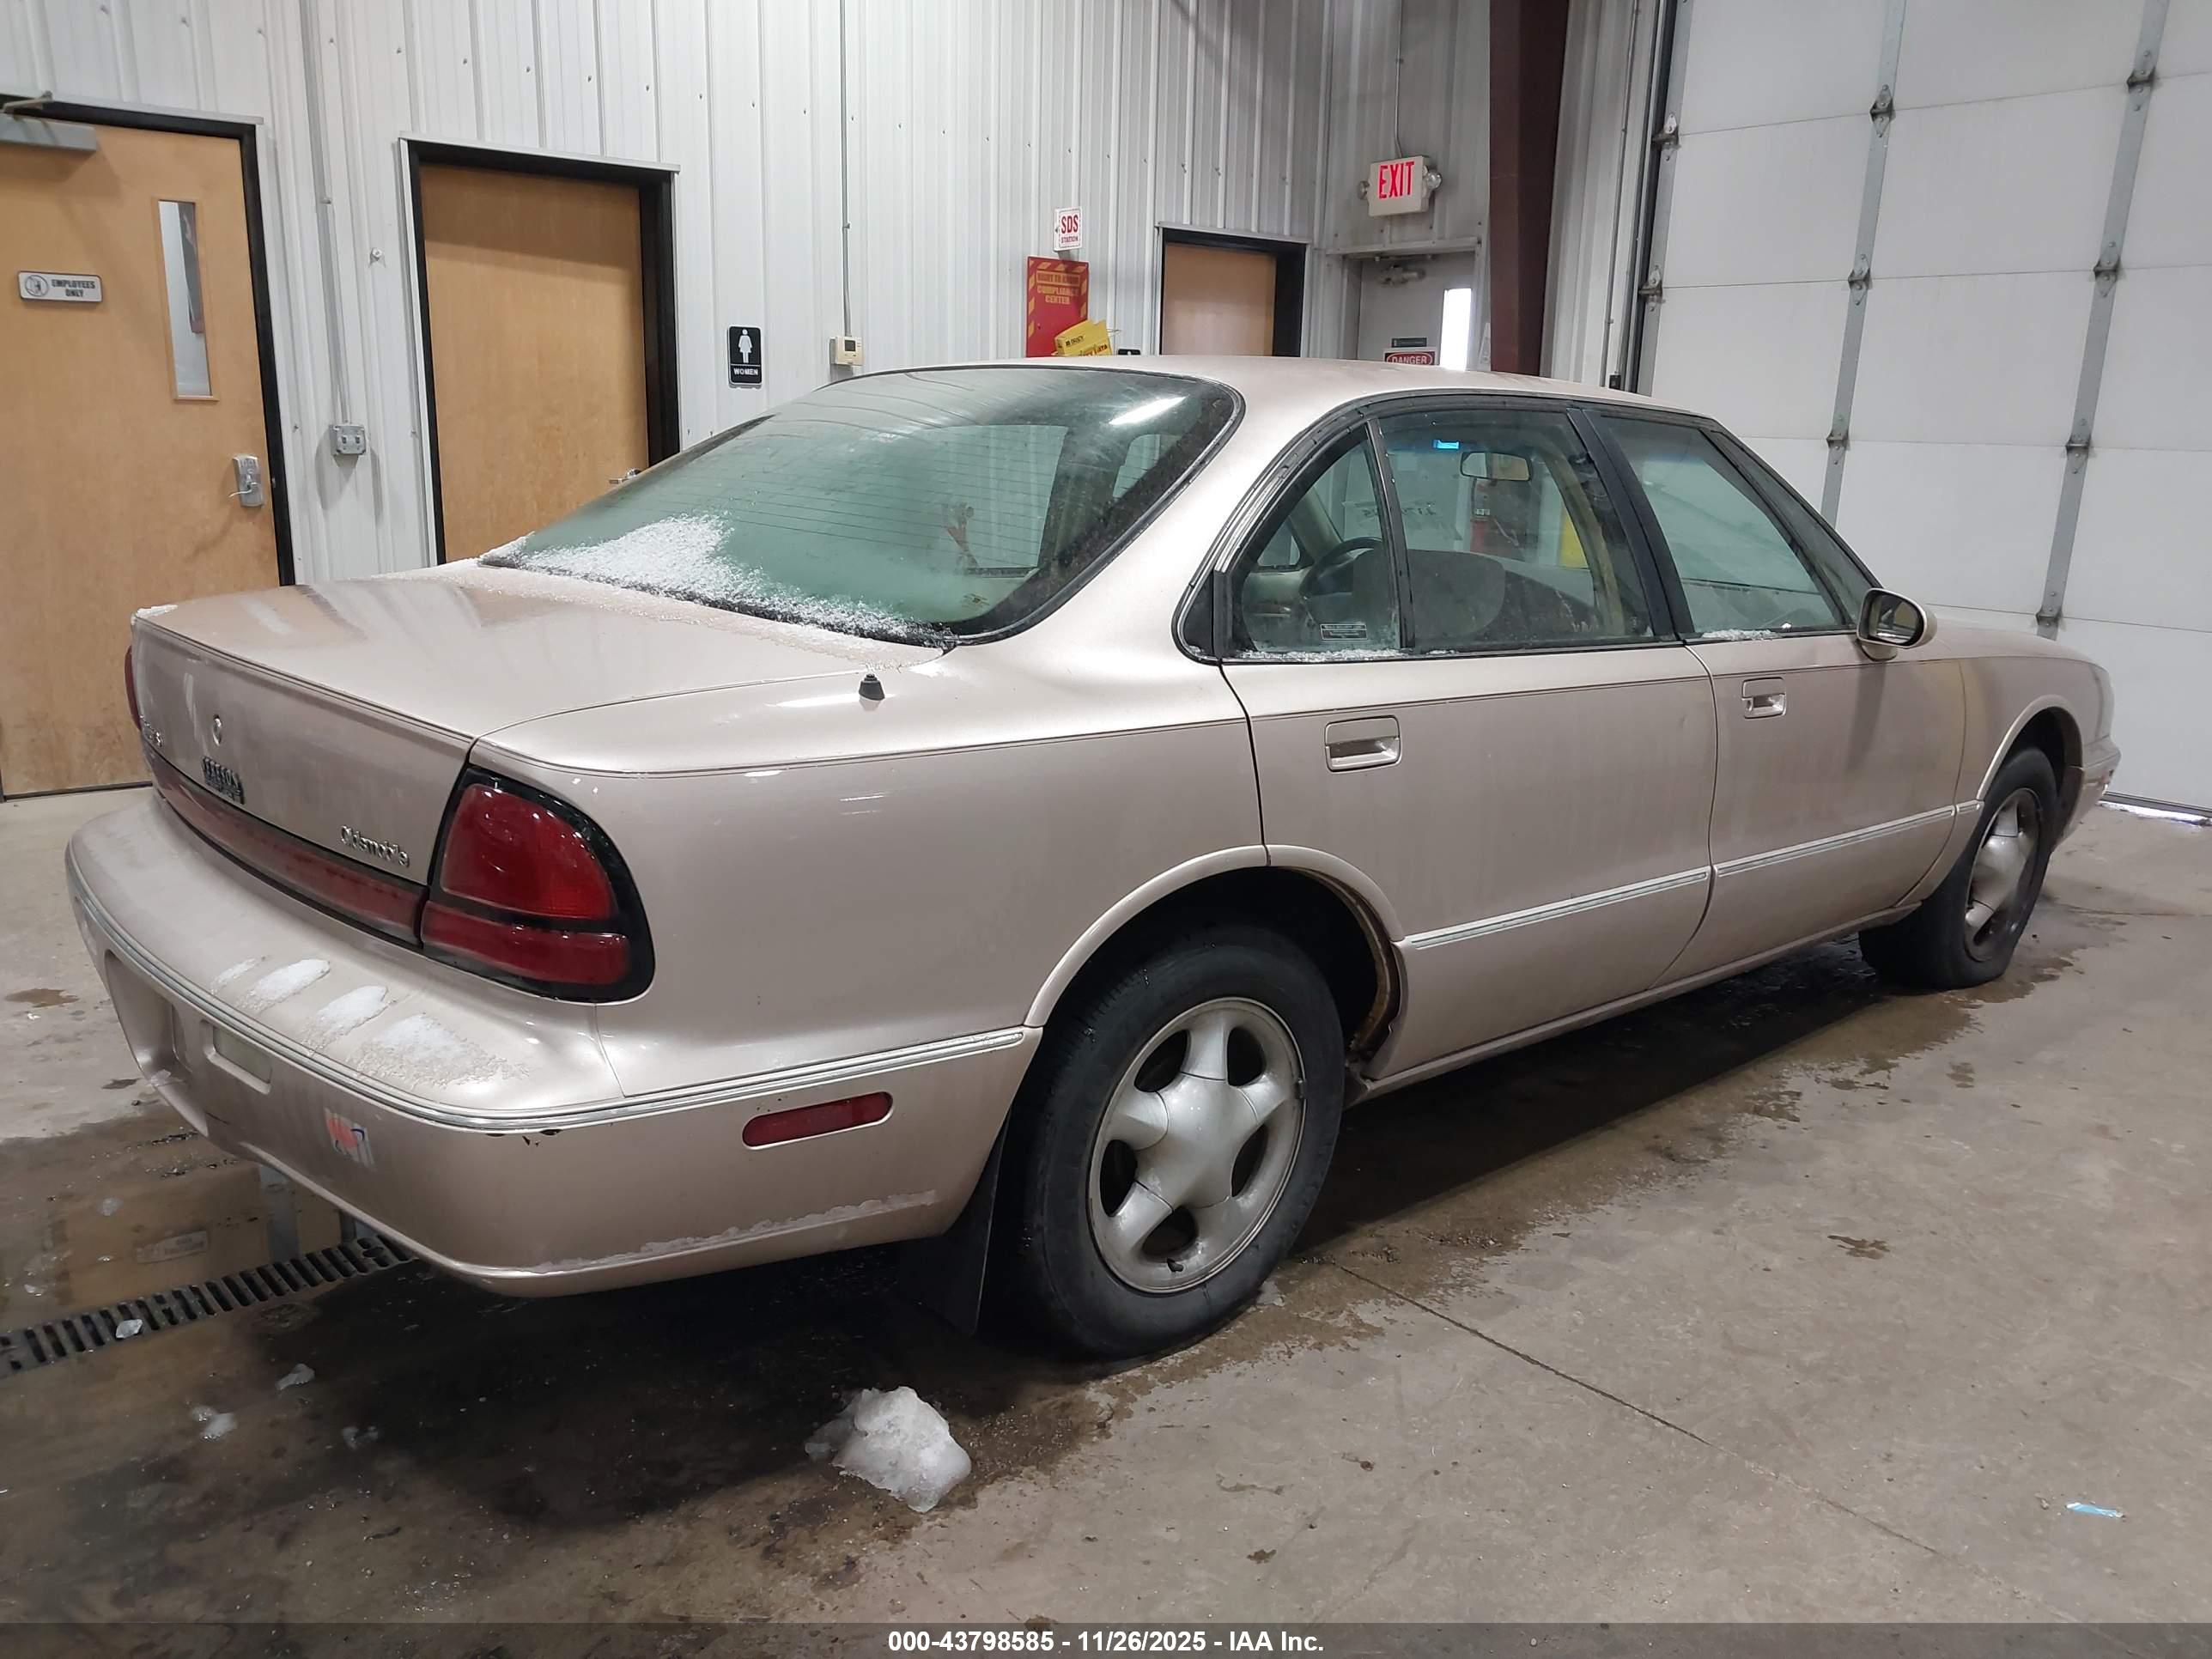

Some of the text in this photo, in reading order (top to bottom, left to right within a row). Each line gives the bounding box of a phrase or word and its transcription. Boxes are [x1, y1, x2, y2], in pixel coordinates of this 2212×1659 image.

[1378, 161, 1415, 198] EXIT
[1060, 214, 1079, 234] SDS
[52, 279, 96, 289] EMPLOYEES
[65, 289, 84, 297] ONLY
[1037, 286, 1079, 295] COMPLIANCE
[1391, 356, 1427, 365] DANGER
